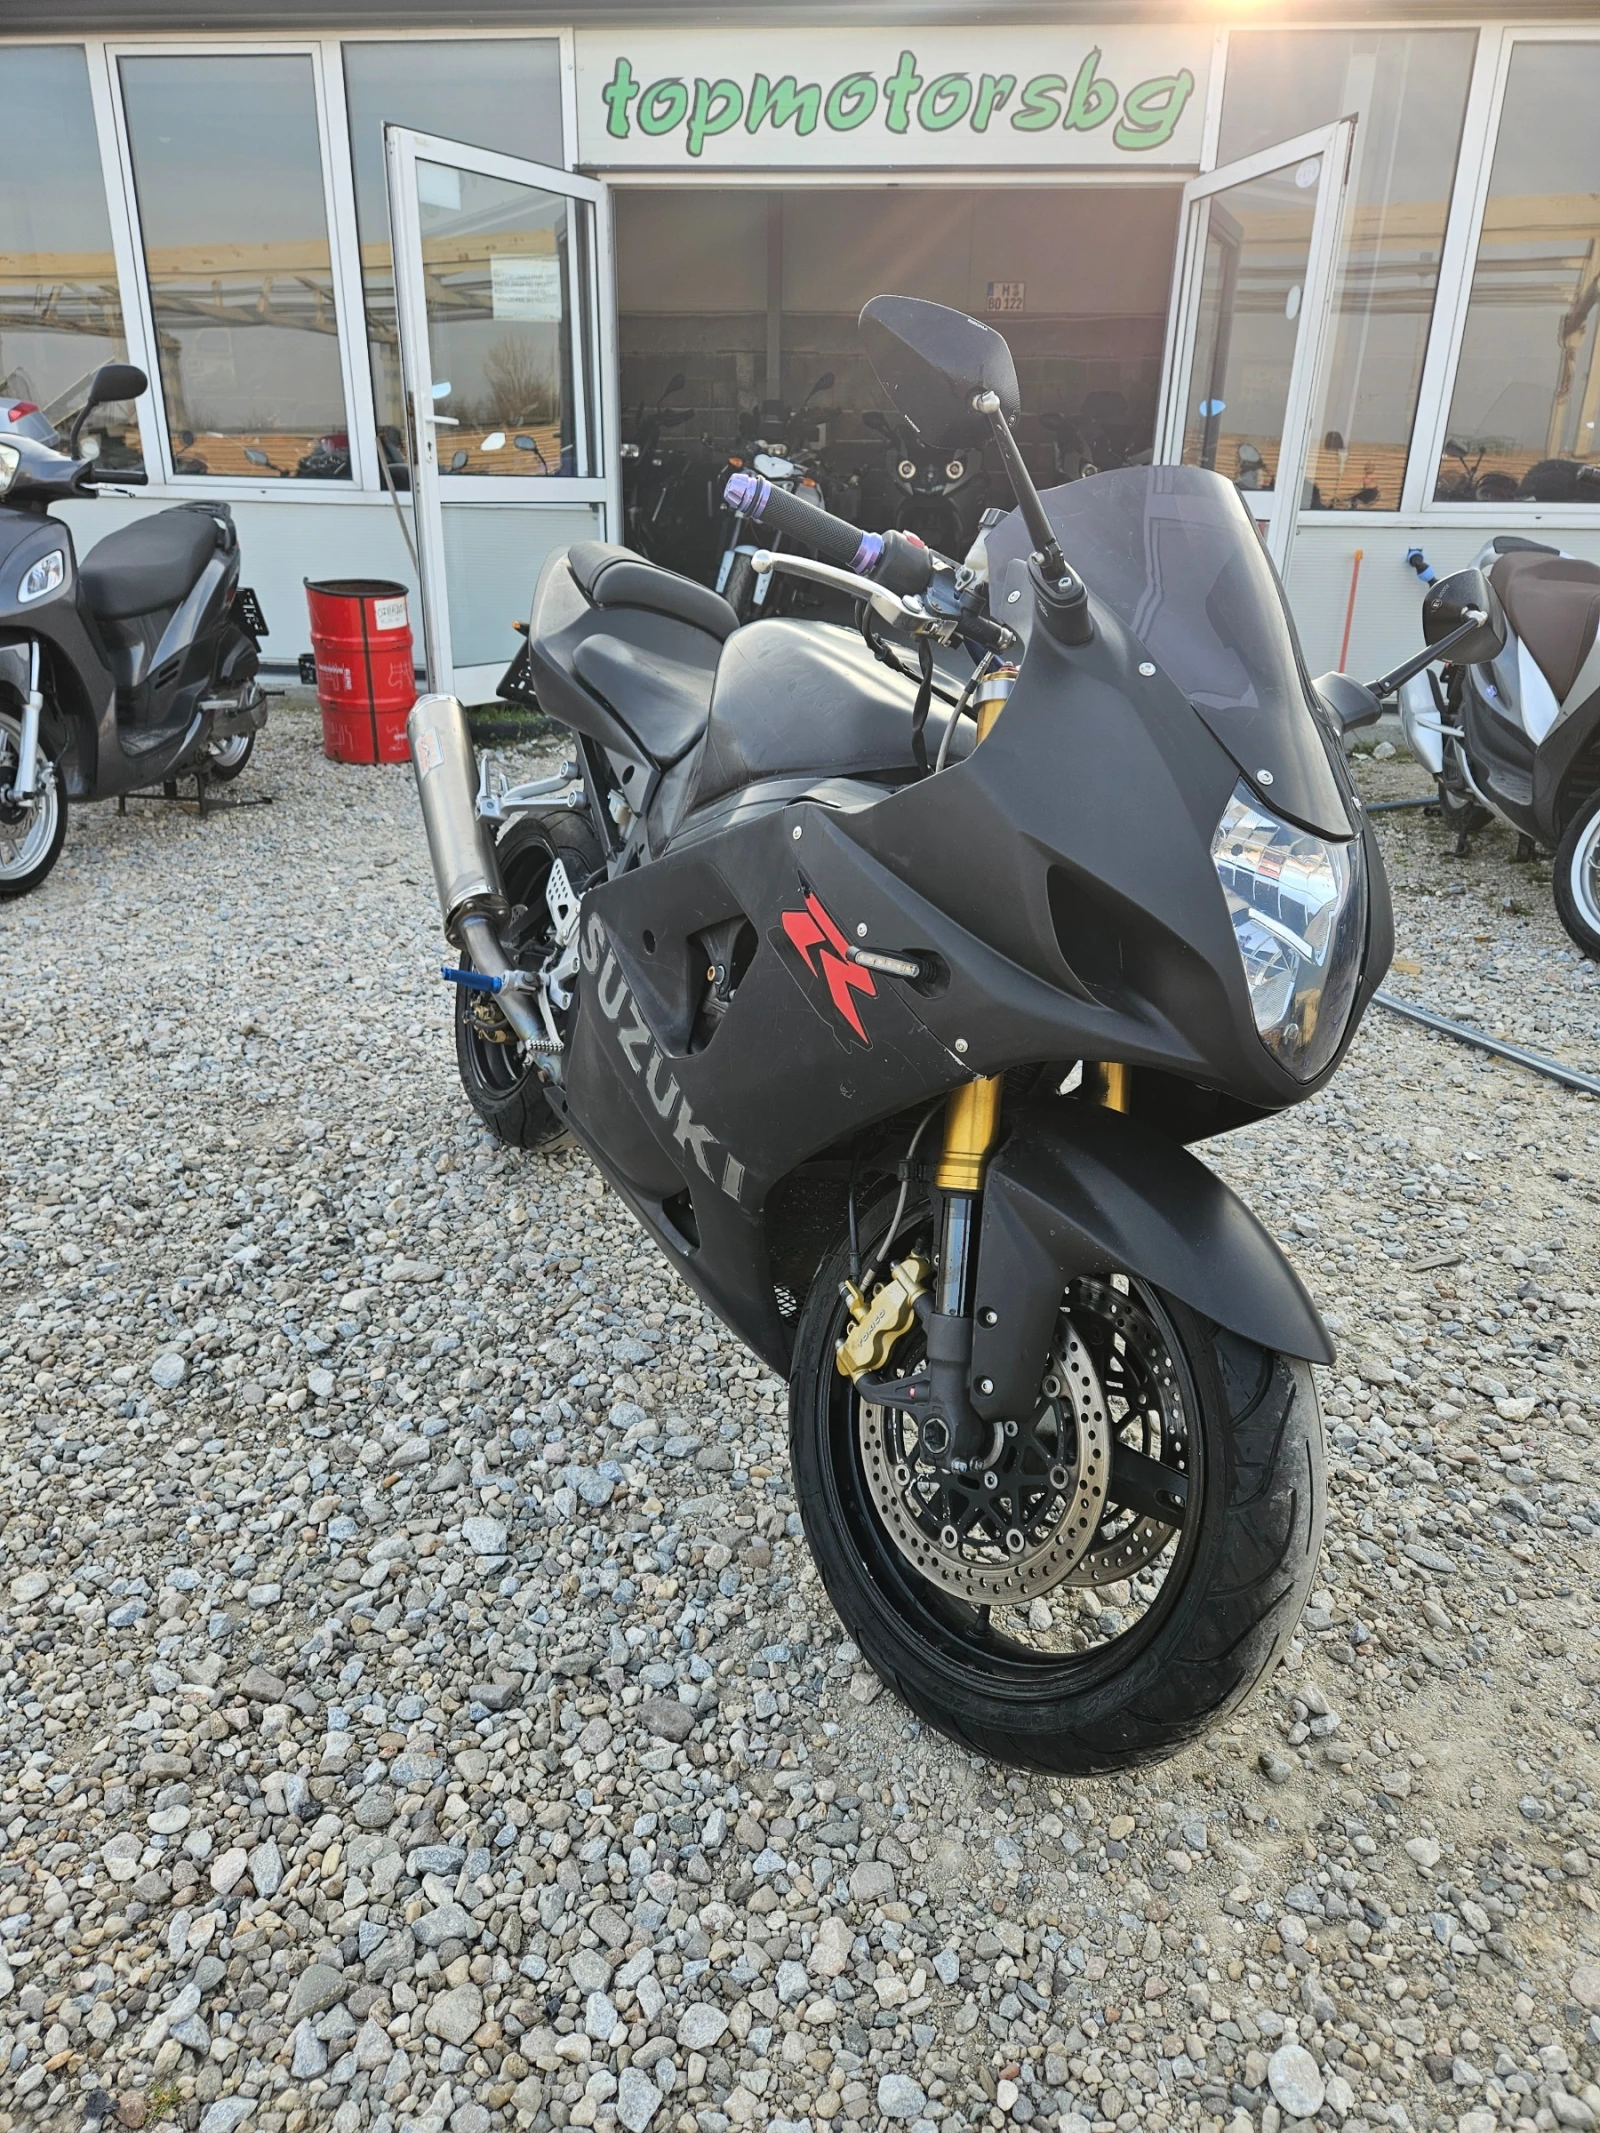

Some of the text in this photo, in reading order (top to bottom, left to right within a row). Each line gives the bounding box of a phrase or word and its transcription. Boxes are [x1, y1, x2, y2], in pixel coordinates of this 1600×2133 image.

[602, 45, 1195, 158] topmotorsbg
[1003, 297, 1023, 310] 122
[580, 911, 745, 1202] SUZUKI
